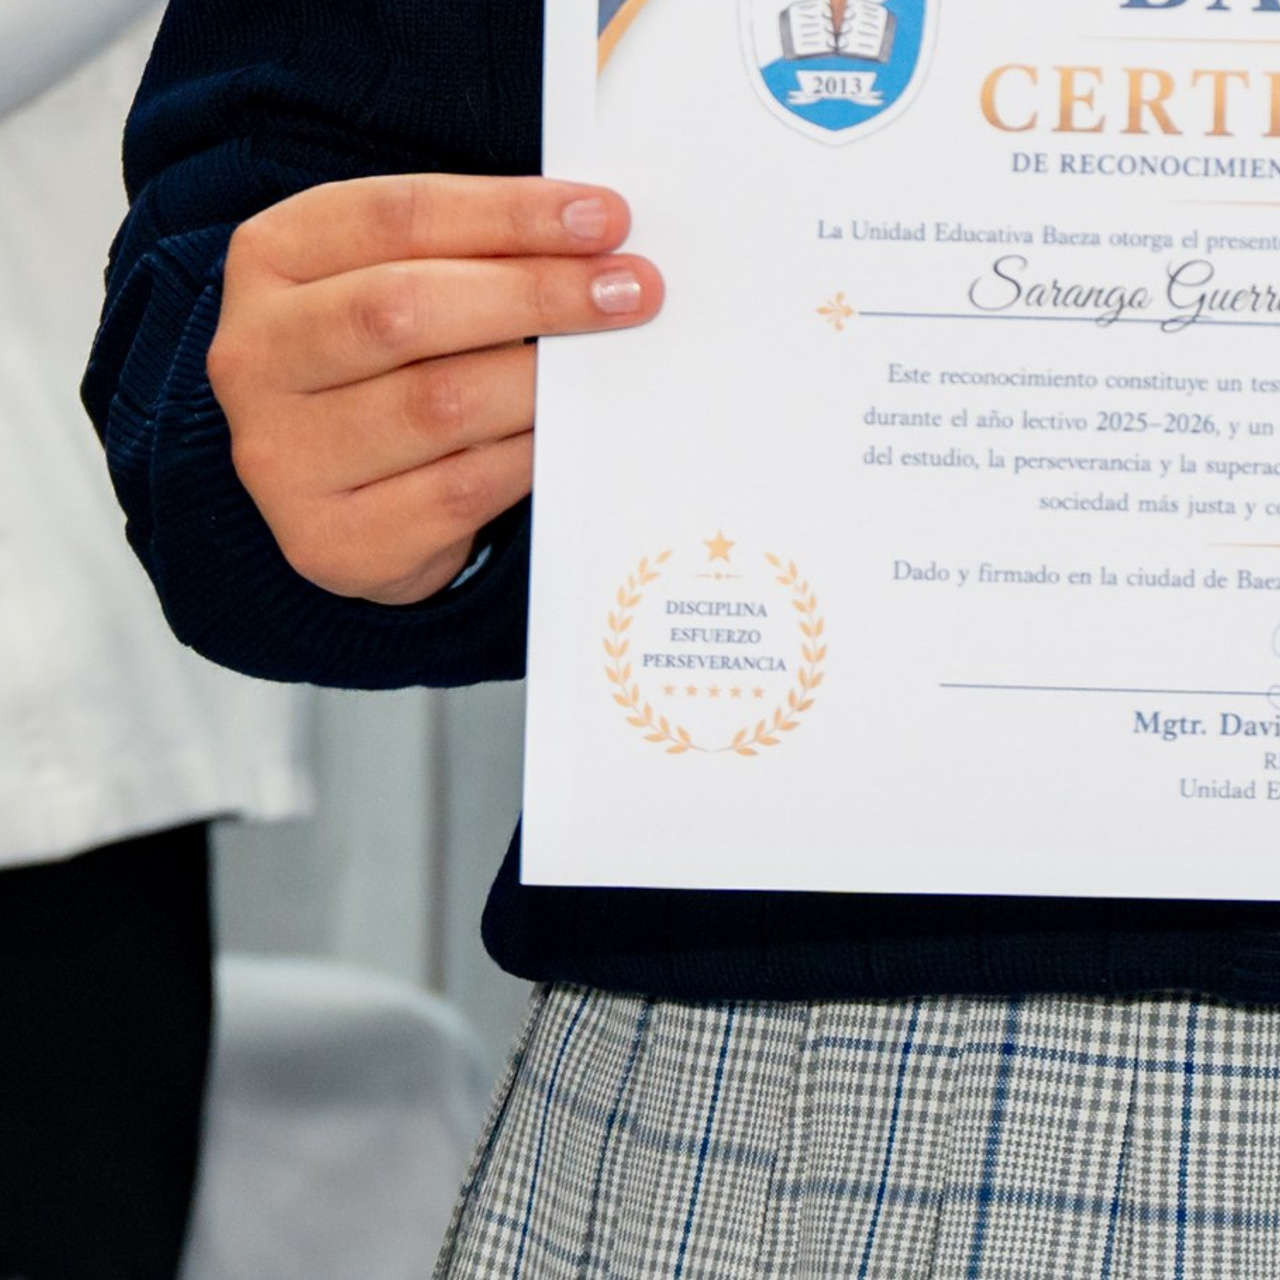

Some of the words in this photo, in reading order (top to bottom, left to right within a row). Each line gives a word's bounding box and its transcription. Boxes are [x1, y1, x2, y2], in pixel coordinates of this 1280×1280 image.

[812, 75, 863, 96] 2013
[1012, 152, 1045, 173] DE
[817, 219, 843, 240] La
[852, 220, 926, 242] Unidad
[934, 222, 1034, 244] Educativa
[1042, 225, 1101, 246] Baeza
[1108, 232, 1174, 253] otorga
[1181, 230, 1198, 249] el
[968, 254, 1150, 327] Sarango
[887, 362, 932, 384] Este
[939, 371, 1099, 388] reconocimiento
[1104, 375, 1209, 396] constituye
[1216, 378, 1243, 393] un
[863, 405, 943, 428] durante
[950, 408, 968, 428] el
[975, 410, 1015, 429] año
[1021, 409, 1088, 431] lectivo
[1228, 421, 1240, 440] y
[1248, 422, 1274, 436] un
[862, 445, 893, 466] del
[899, 447, 980, 470] estudio,
[988, 448, 1006, 469] la
[1013, 454, 1152, 475] perseverancia
[1160, 459, 1172, 478] y
[1179, 453, 1197, 474] la
[1039, 492, 1130, 512] sociedad
[1138, 495, 1180, 514] más
[1187, 499, 1236, 519] justa
[1245, 502, 1256, 521] y
[893, 559, 951, 581] Dado
[957, 569, 970, 588] y
[978, 562, 1061, 585] firmado
[1067, 571, 1092, 585] en
[1100, 565, 1118, 586] la
[1125, 567, 1196, 589] ciudad
[1202, 568, 1228, 589] de
[665, 600, 768, 618] DISCIPLINA
[670, 627, 762, 644] ESFUERZO
[642, 653, 787, 672] PERSEVERANCIA
[1133, 710, 1207, 742] Mgtr.
[1179, 778, 1256, 800] Unidad
